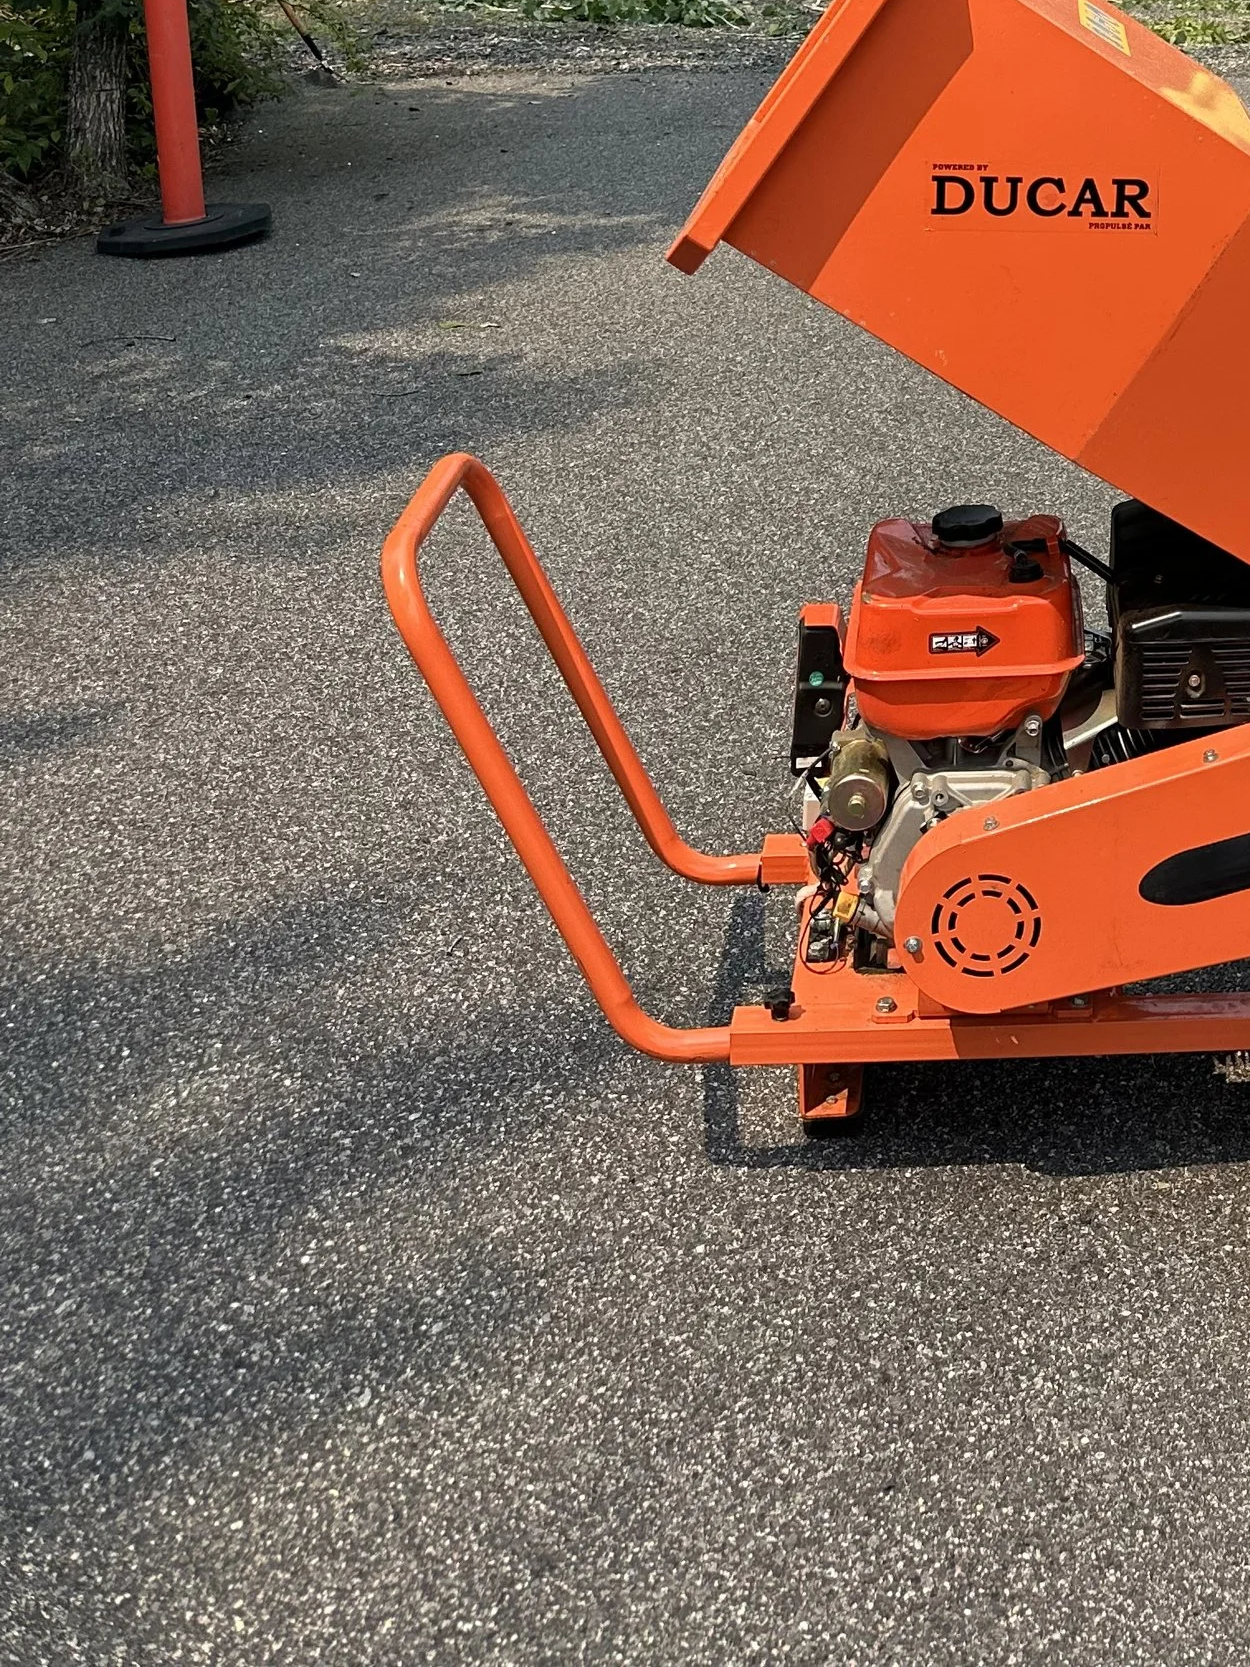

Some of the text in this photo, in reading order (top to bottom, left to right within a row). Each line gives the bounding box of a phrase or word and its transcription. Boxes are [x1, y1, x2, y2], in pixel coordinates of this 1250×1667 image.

[932, 163, 989, 172] POWERED BY
[931, 175, 1151, 218] DUCAR
